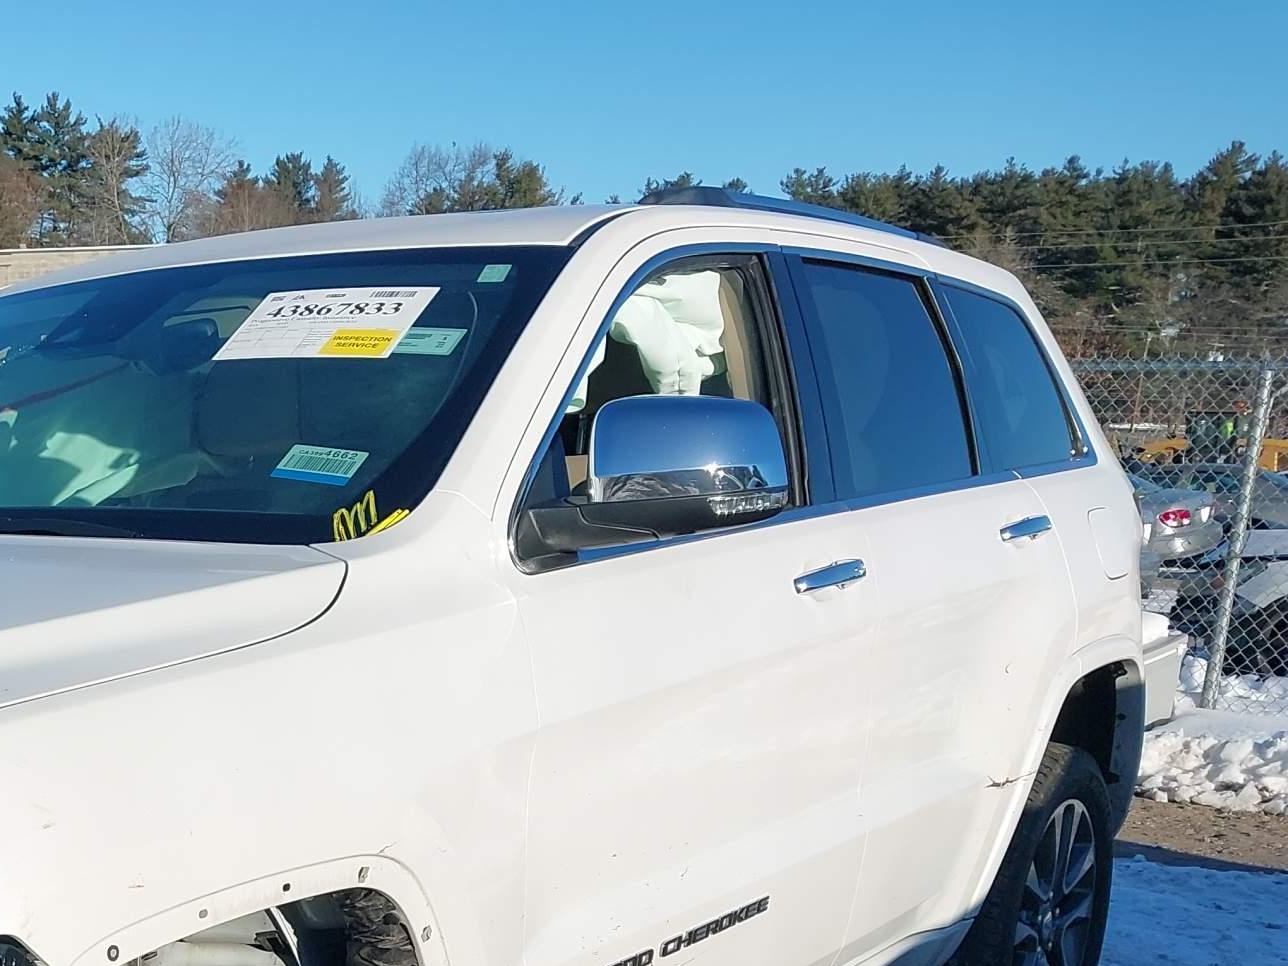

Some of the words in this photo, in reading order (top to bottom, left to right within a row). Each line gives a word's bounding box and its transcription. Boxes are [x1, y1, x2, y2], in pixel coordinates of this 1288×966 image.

[266, 302, 403, 318] 43867833
[332, 335, 393, 343] INSPECTION
[659, 896, 771, 957] CHEROKEE
